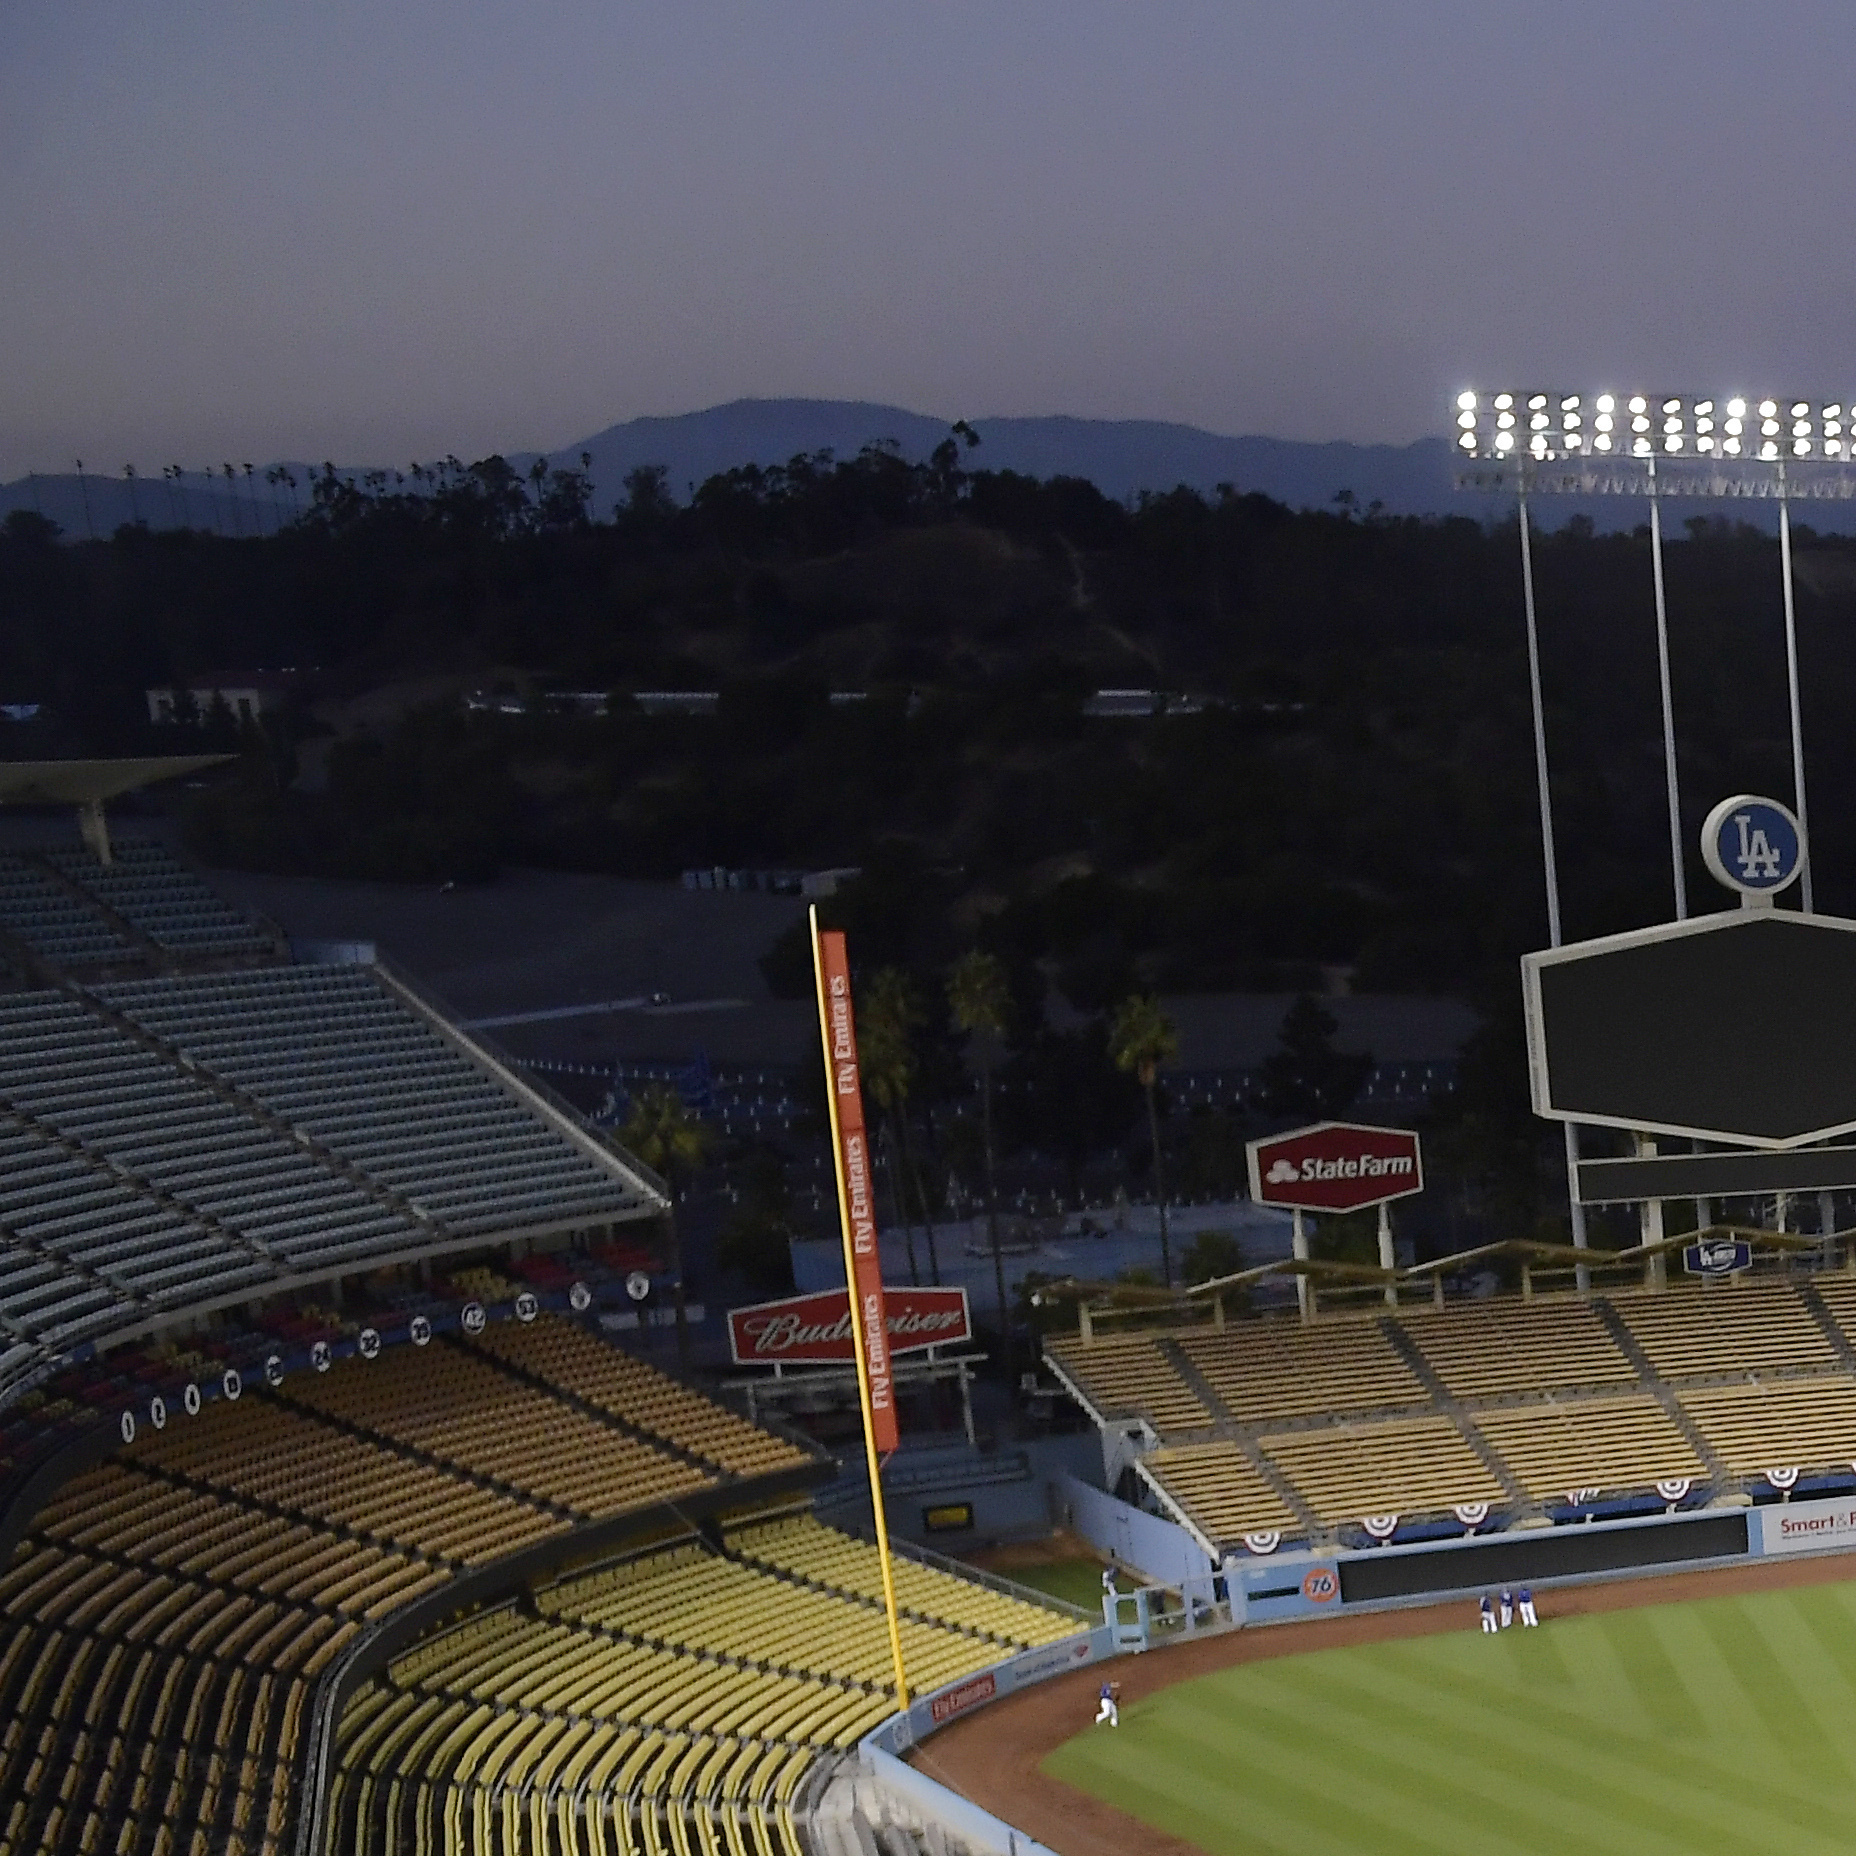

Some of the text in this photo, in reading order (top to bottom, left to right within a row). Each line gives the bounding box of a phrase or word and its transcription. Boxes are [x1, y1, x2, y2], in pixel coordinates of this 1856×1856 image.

[1735, 815, 1780, 878] LA
[838, 1063, 857, 1094] Fly
[846, 1136, 874, 1254] Fly Emirates
[743, 1307, 963, 1352] Budeiser
[864, 1294, 890, 1410] Fly Emirates
[1781, 1515, 1834, 1534] Smart
[1312, 1577, 1332, 1594] 76
